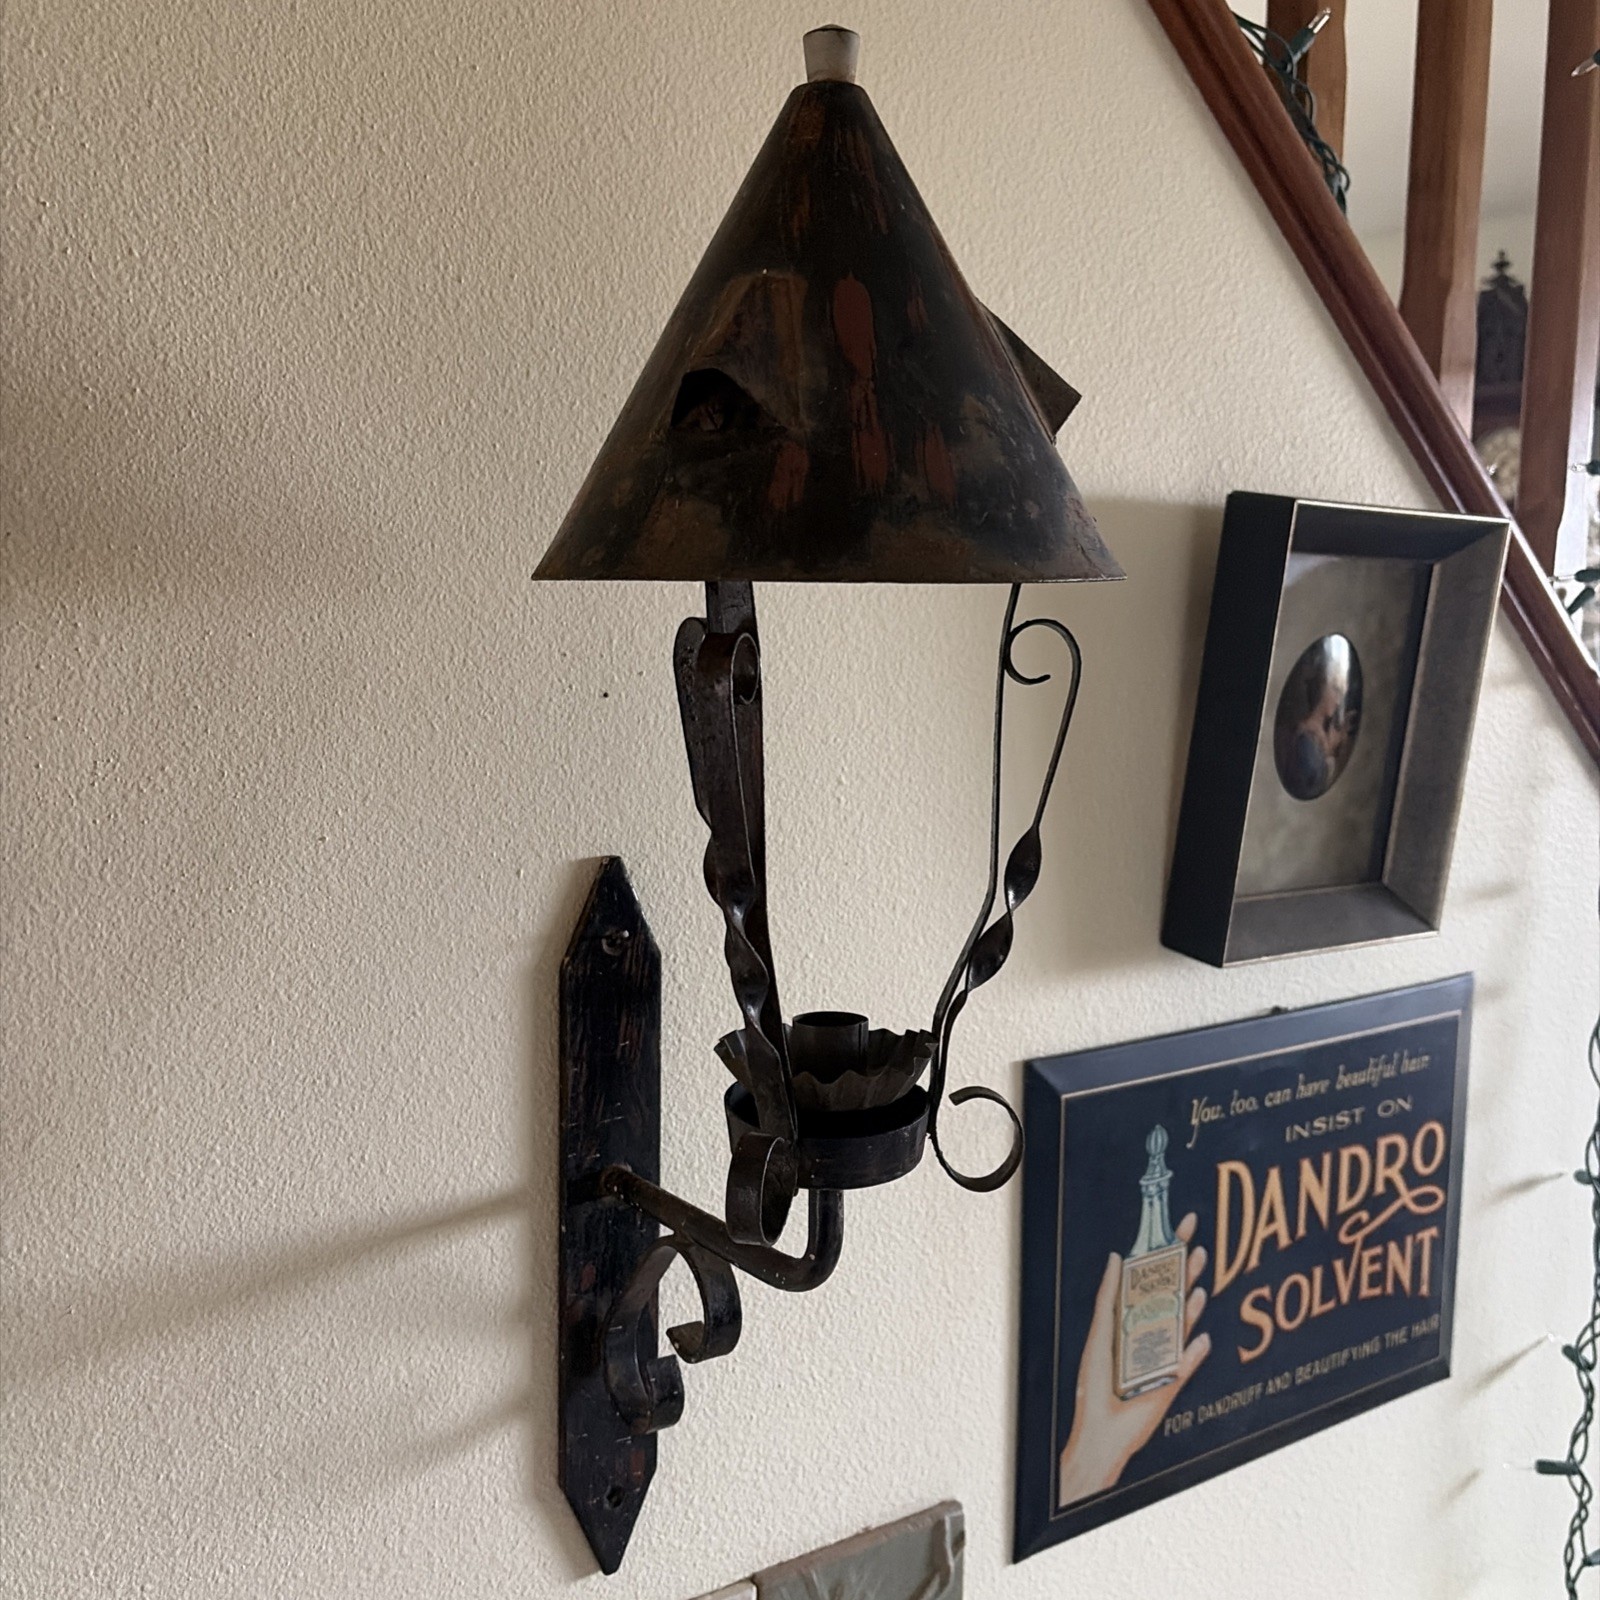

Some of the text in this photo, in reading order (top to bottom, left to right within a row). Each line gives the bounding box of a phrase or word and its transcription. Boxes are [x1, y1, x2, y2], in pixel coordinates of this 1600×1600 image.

[1264, 1088, 1292, 1108] can
[1296, 1073, 1330, 1100] have
[1285, 1095, 1414, 1143] INSIST ON
[1211, 1120, 1446, 1298] DANDRO
[1237, 1226, 1439, 1364] SOLVENT
[1164, 1410, 1194, 1437] FOR
[1265, 1371, 1293, 1395] AND
[1384, 1326, 1408, 1349] THE
